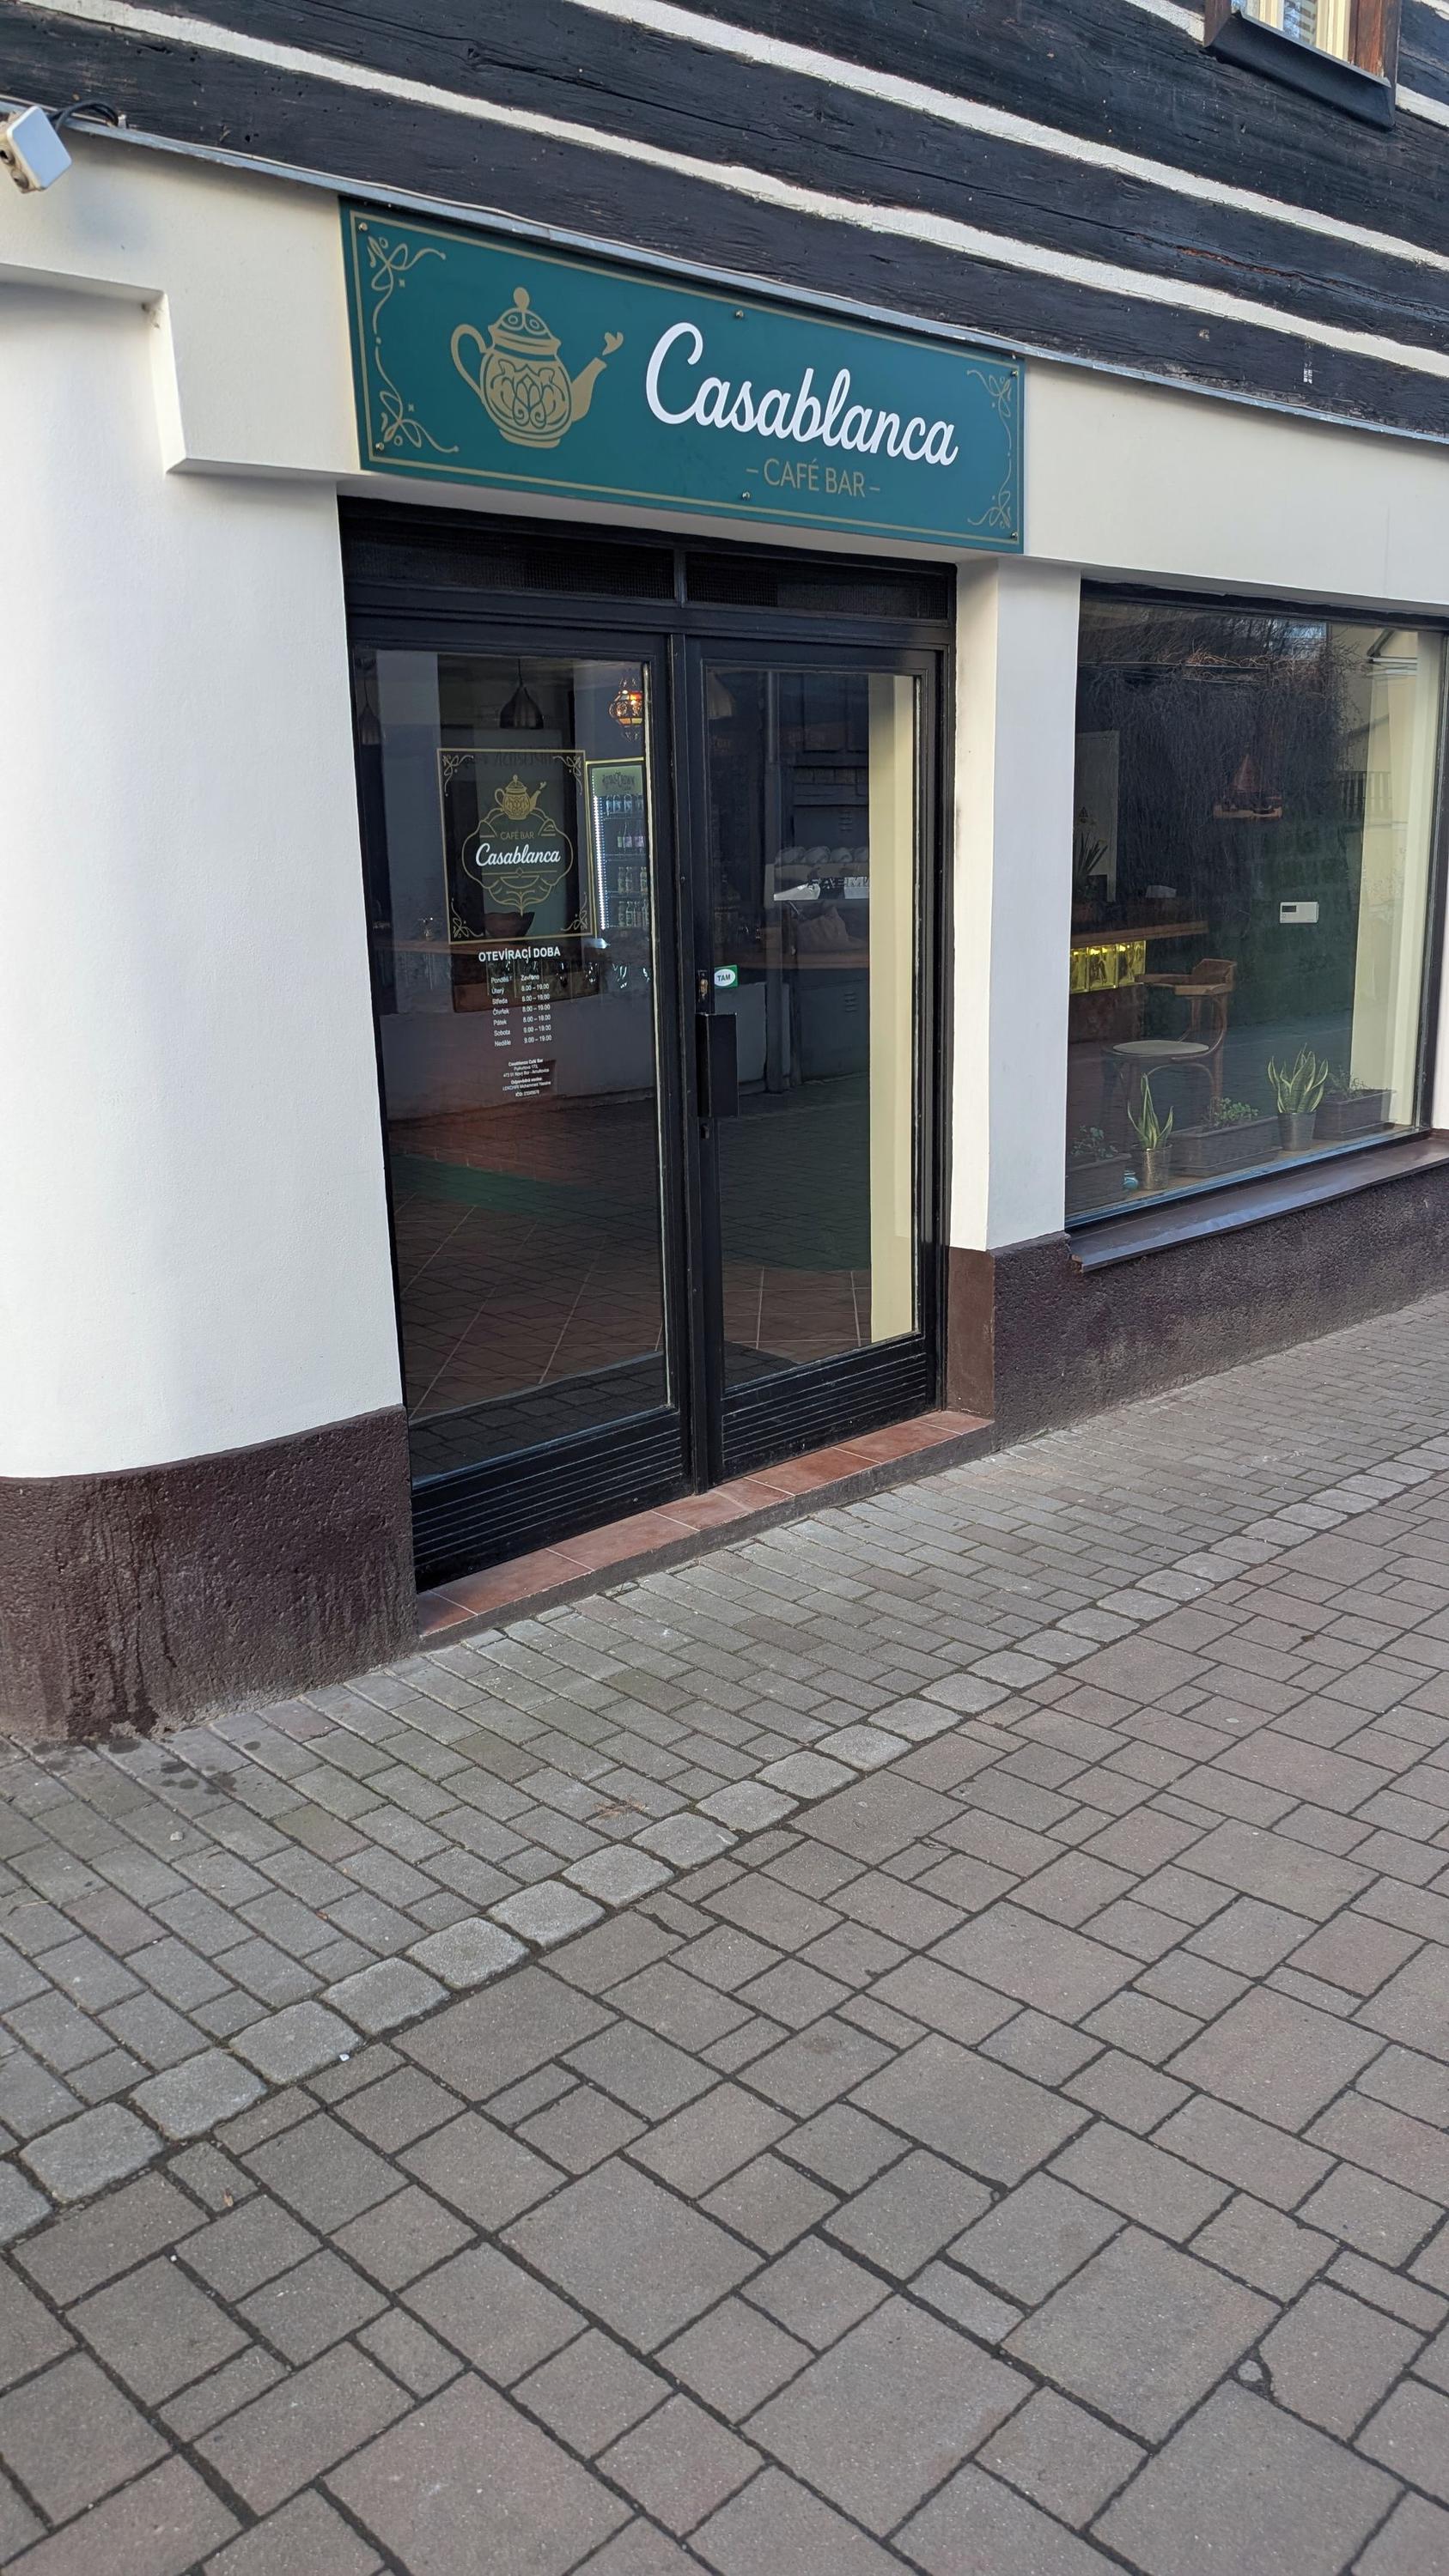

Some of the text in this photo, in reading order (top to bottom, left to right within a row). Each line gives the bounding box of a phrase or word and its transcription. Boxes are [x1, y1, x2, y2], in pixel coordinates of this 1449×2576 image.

[645, 322, 959, 466] Casablanca
[764, 457, 865, 497] CAFÉ BAR
[500, 829, 534, 841] CAFÉ BAR
[475, 842, 561, 866] Casablanca
[478, 945, 561, 963] OTEVÍRACÍ DOBA
